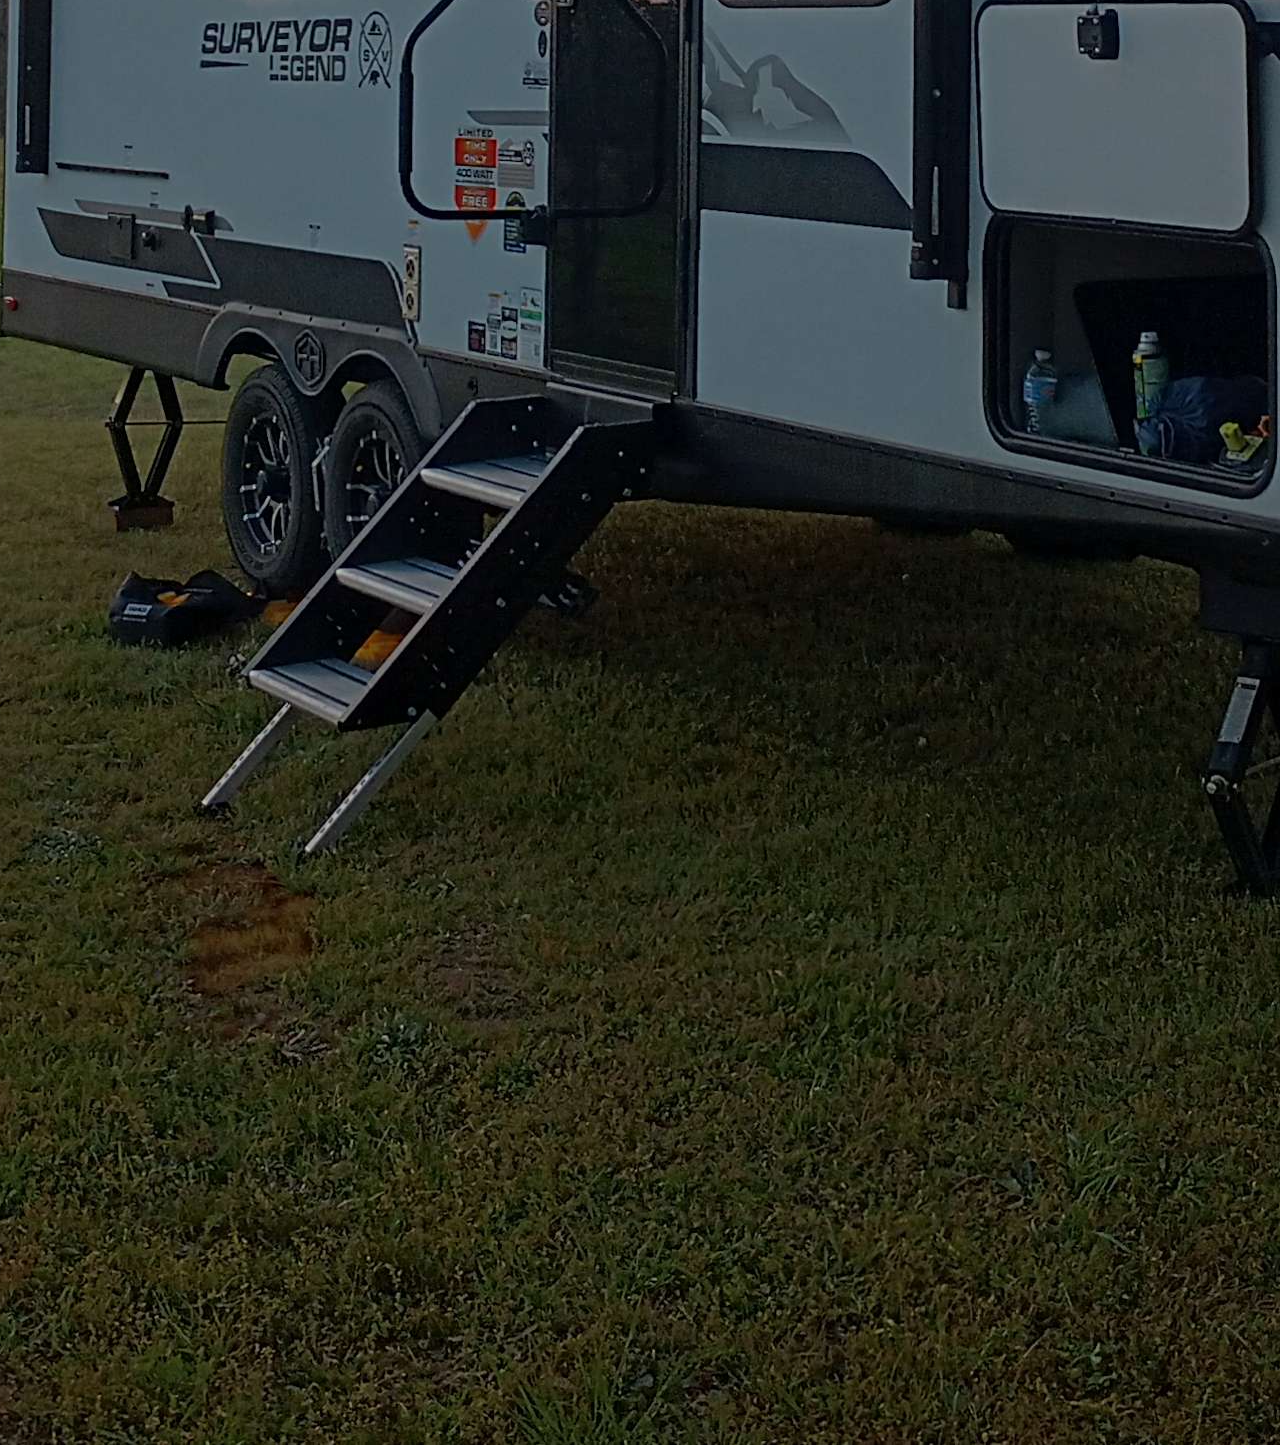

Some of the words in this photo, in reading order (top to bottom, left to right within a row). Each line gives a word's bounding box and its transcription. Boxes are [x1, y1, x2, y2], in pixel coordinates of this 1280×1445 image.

[201, 18, 353, 55] SURVEYOR
[269, 55, 346, 82] LEGEND
[458, 127, 494, 138] LIMITED
[463, 153, 488, 164] ONLY
[462, 195, 488, 208] FREE
